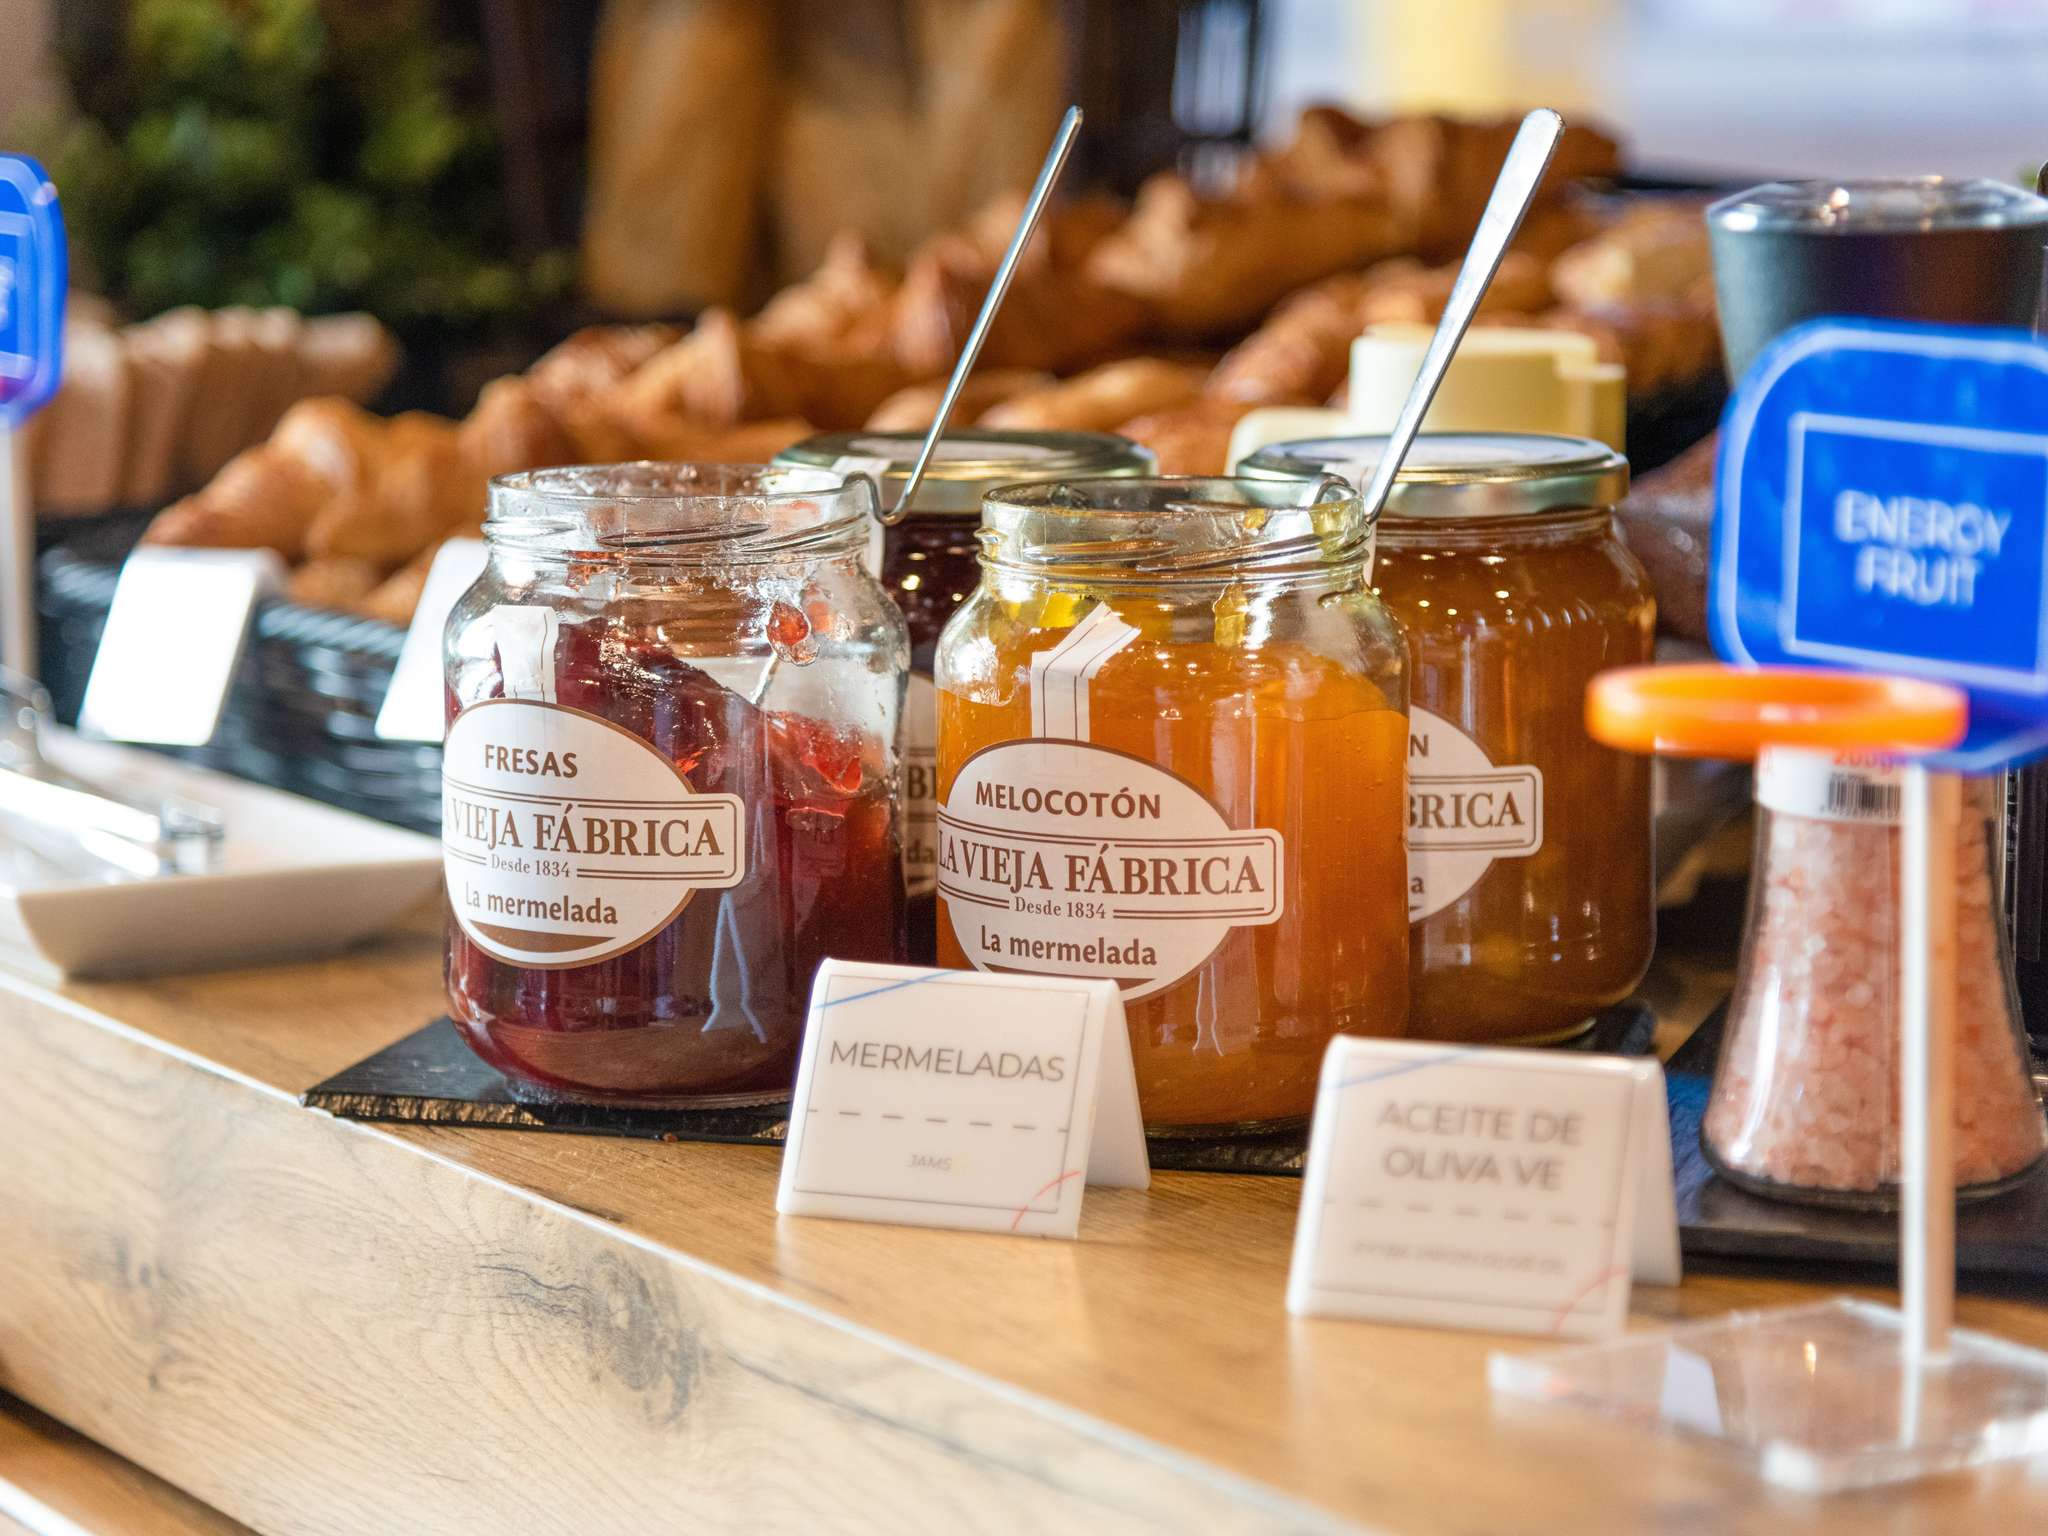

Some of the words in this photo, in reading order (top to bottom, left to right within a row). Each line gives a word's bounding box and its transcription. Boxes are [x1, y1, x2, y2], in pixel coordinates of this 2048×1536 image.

[1834, 489, 2011, 556] ENERGY
[1855, 545, 1983, 608] FRUIT
[484, 744, 578, 778] FRESAS
[975, 781, 1161, 819] MELOCOTÓN
[533, 803, 724, 857] FÁBRICA
[490, 853, 530, 874] Desde
[535, 859, 570, 878] 1834
[960, 839, 1053, 894] VIEJA
[1064, 843, 1265, 896] FÁBRICA
[465, 881, 480, 908] La
[487, 893, 618, 925] mermelada
[1014, 896, 1062, 917] Desde
[1066, 901, 1107, 919] 1834
[981, 924, 1001, 953] La
[1009, 935, 1157, 966] mermelada
[829, 1040, 1065, 1082] MERMELADAS
[1377, 1101, 1513, 1141] ACEITE
[1527, 1112, 1584, 1147] DE
[908, 1154, 952, 1172] JAMS
[1382, 1146, 1502, 1184] OLIVA
[1514, 1156, 1564, 1191] VE
